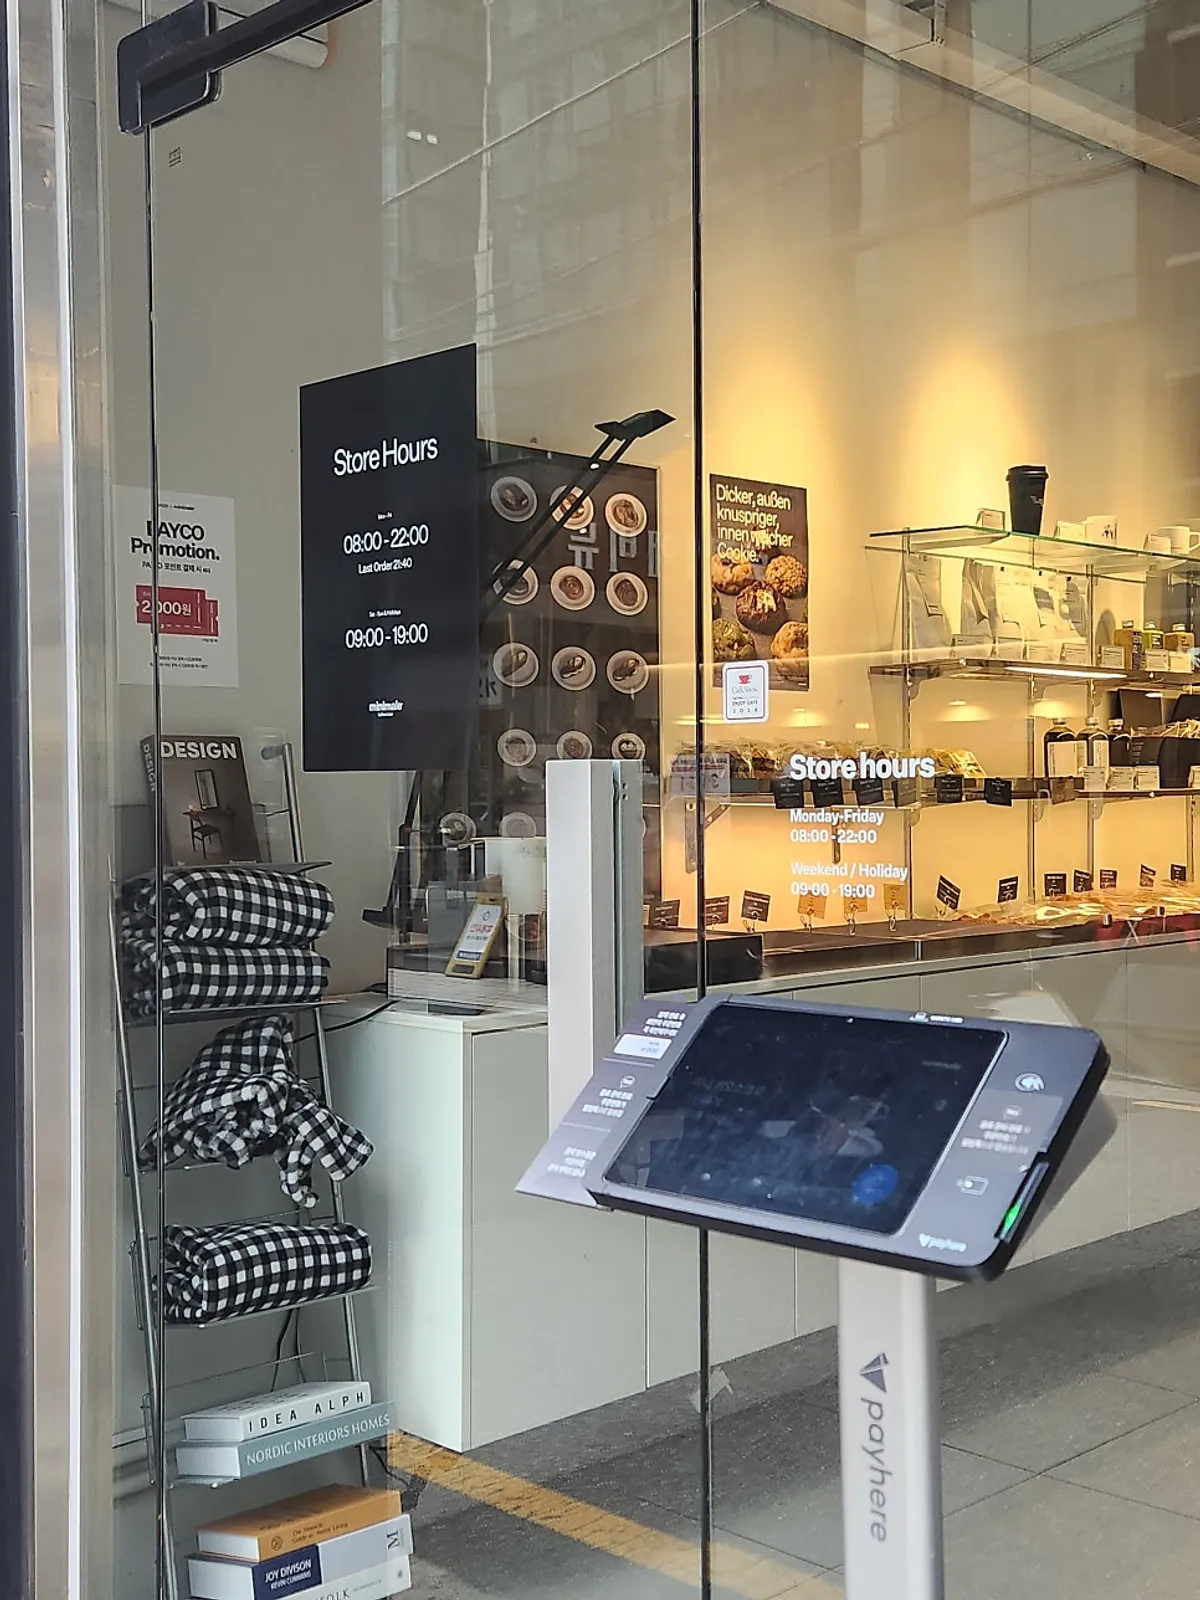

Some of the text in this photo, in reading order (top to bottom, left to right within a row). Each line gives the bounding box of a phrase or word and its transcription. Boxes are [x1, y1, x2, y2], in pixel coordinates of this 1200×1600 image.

[333, 437, 439, 477] Store Hours
[715, 483, 791, 510] Dicker, außen
[716, 503, 779, 531] knuspriger,
[343, 530, 382, 555] 08:00
[390, 524, 429, 548] 22:00
[716, 522, 749, 543] innen
[717, 542, 759, 562] Cookie.
[358, 563, 373, 574] Last
[373, 560, 393, 573] Order
[345, 627, 384, 648] 09:00
[392, 623, 428, 645] 19:00
[160, 741, 237, 759] DESIGN
[789, 751, 936, 780] Store hours
[790, 829, 829, 843] 08:00
[837, 829, 877, 844] 22:00
[790, 861, 848, 877] Weekend
[858, 864, 908, 881] Holiday
[791, 882, 829, 896] 09:00
[838, 883, 875, 898] 19:00
[249, 1409, 297, 1432] IDEA
[314, 1391, 364, 1415] ALPH
[246, 1413, 390, 1465] NORDIC INTERIORS HOMES
[860, 1396, 893, 1543] payhere
[264, 1569, 280, 1583] JOY
